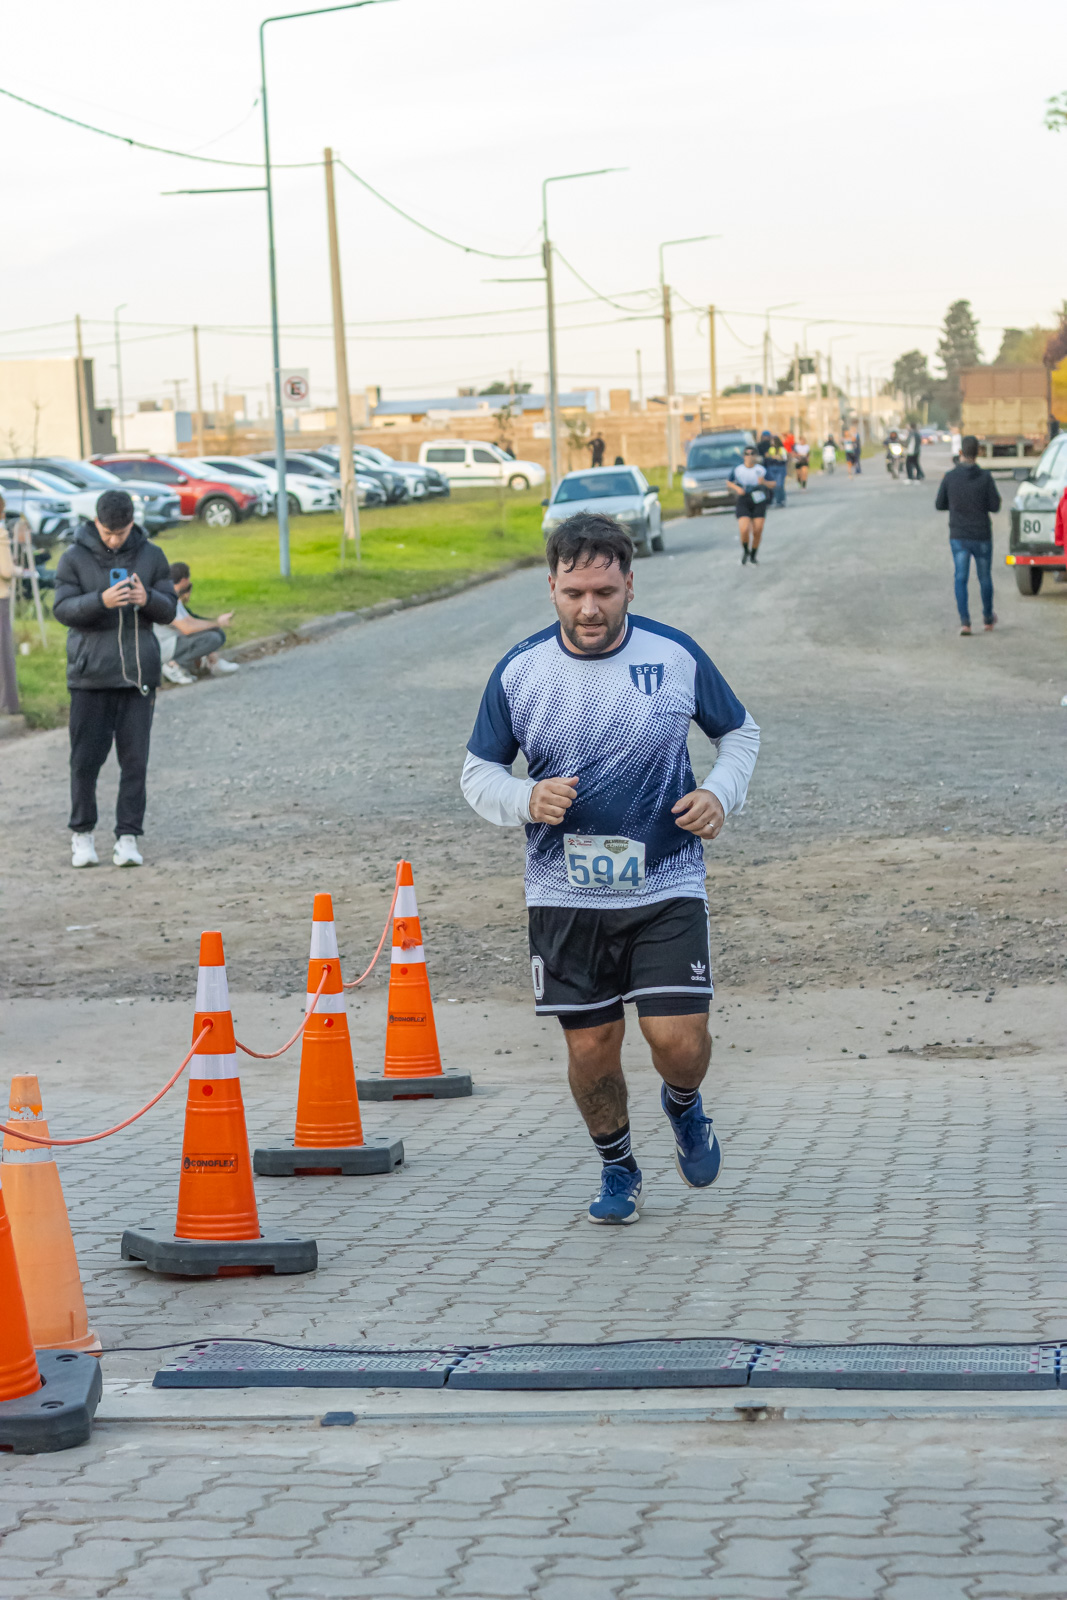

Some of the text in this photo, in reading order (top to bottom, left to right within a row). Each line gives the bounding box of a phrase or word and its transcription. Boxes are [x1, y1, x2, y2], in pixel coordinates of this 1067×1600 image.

[291, 381, 302, 395] E
[1023, 519, 1041, 534] 80
[635, 666, 658, 674] SFC
[568, 853, 642, 887] 594
[190, 1159, 234, 1167] CONOFLEX
